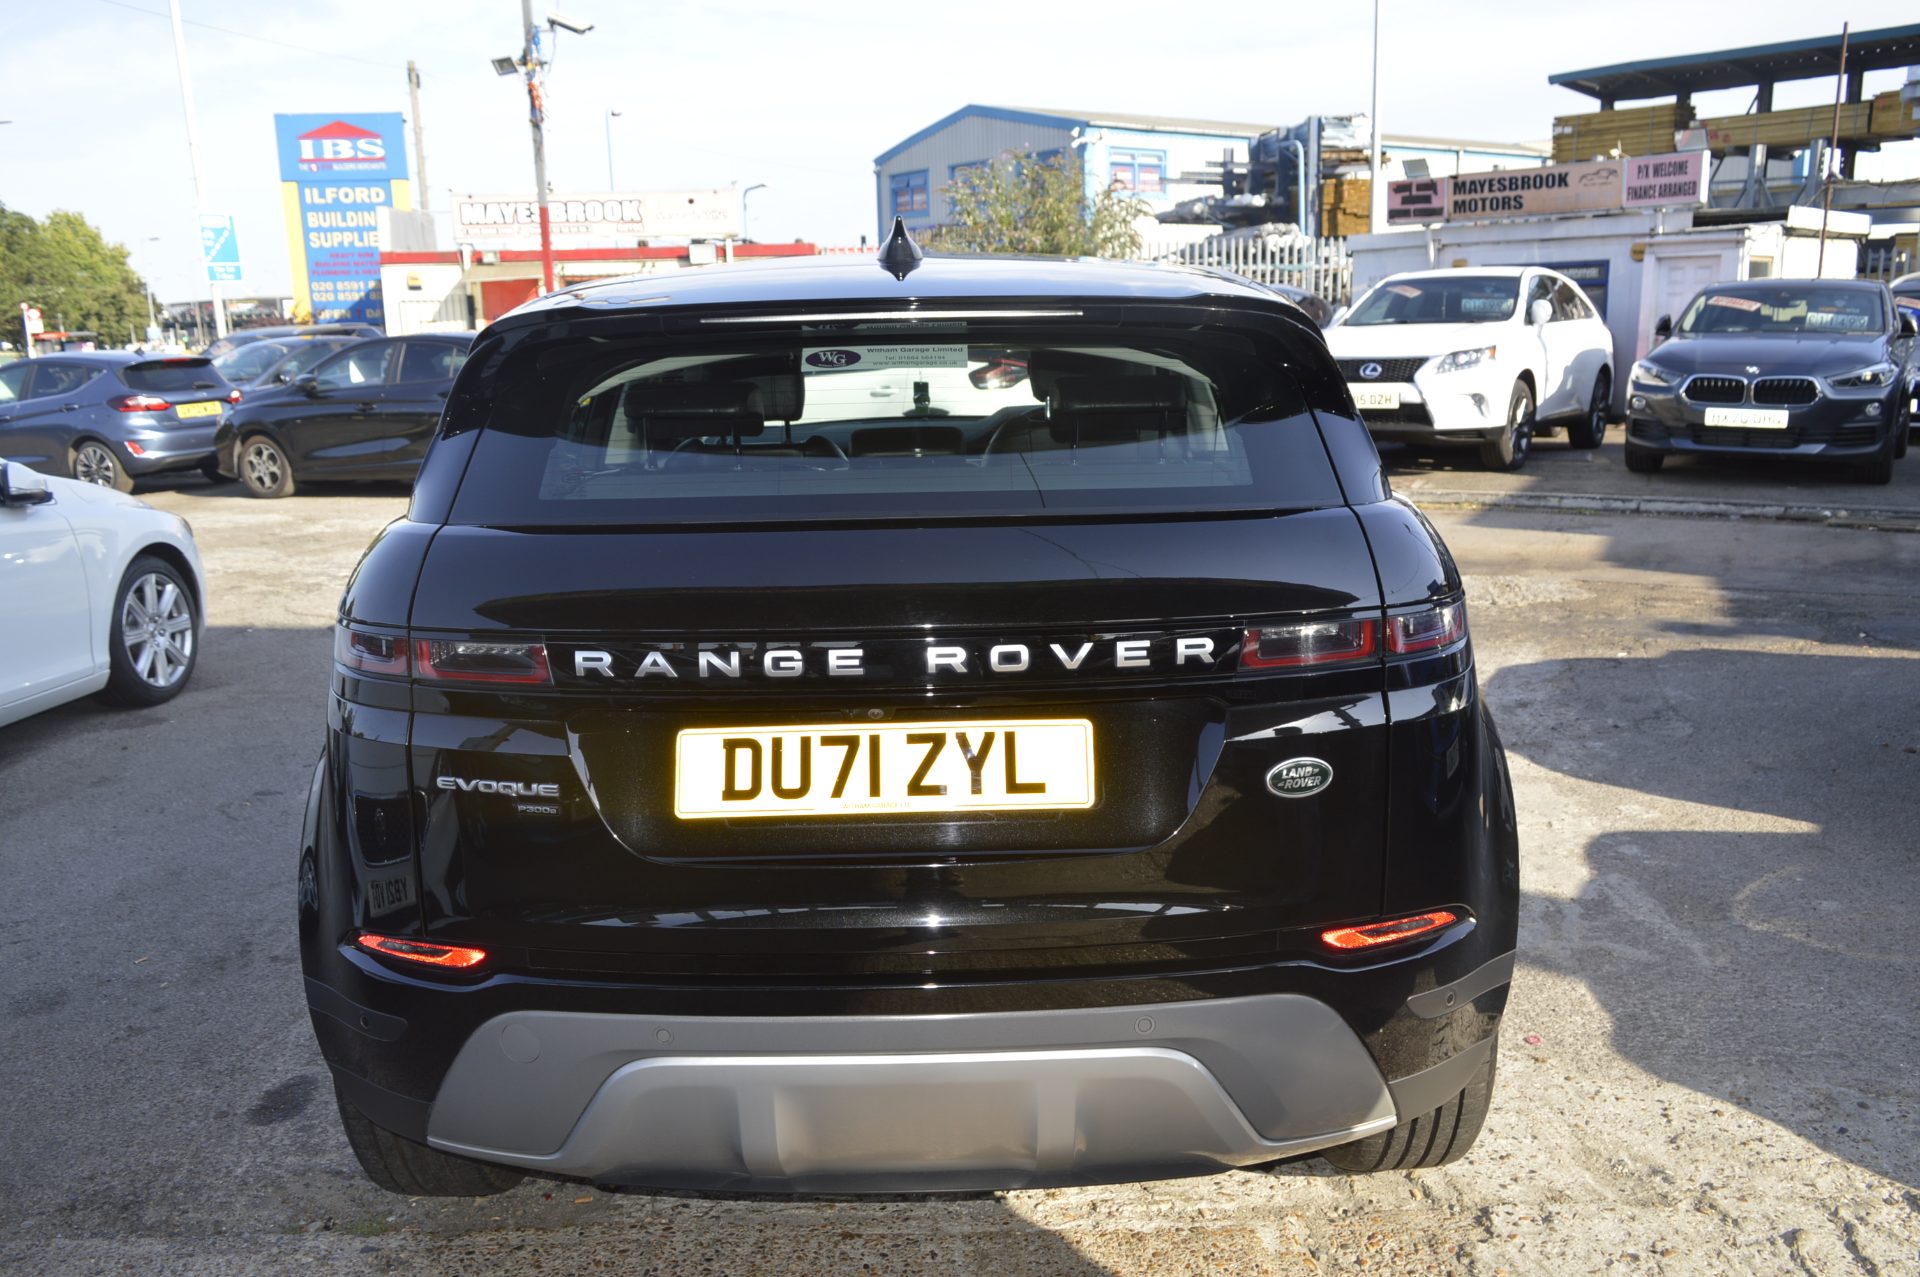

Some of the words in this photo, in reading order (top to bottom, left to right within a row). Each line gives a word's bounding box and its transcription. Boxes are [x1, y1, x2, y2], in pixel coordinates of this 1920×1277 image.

[299, 137, 386, 160] IBS
[1651, 160, 1688, 179] WELCOME
[1453, 171, 1569, 196] MAYESBROOK
[1627, 182, 1658, 201] FINANCE
[1658, 180, 1697, 198] ARRANGED
[304, 186, 386, 204] ILFORD
[1453, 194, 1524, 215] MOTORS
[307, 210, 377, 229] BUILDIN
[309, 231, 380, 248] SUPPLIE
[818, 351, 847, 364] WG
[900, 346, 930, 354] Garage
[573, 647, 865, 678] RANGE
[925, 637, 1216, 674] ROVER
[721, 734, 881, 801] DU71
[906, 731, 1046, 797] ZYL
[1281, 766, 1313, 779] LAND
[435, 775, 560, 797] EVOQUE
[1283, 776, 1322, 789] ROVER
[517, 804, 557, 815] P300e
